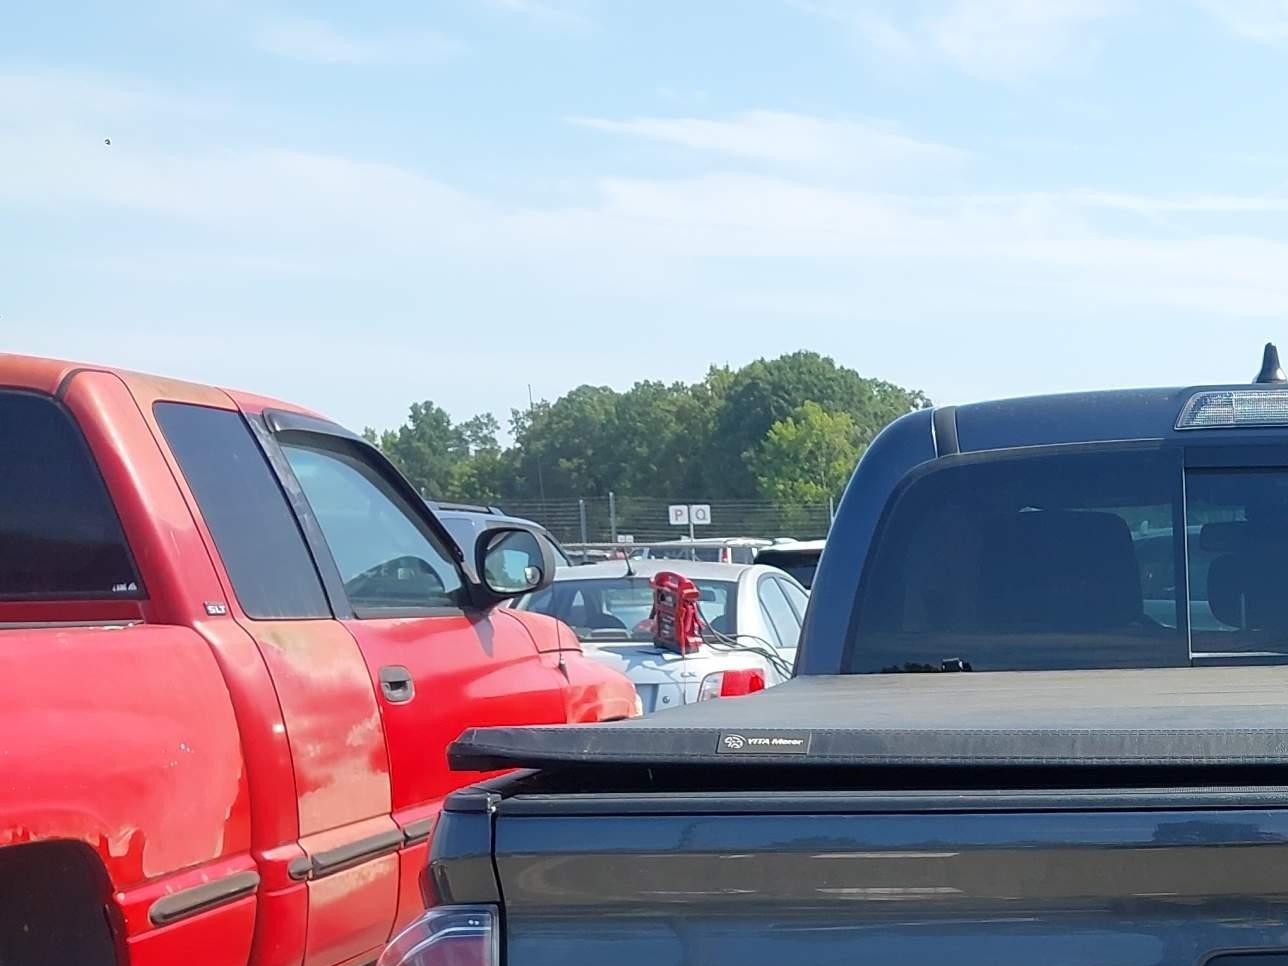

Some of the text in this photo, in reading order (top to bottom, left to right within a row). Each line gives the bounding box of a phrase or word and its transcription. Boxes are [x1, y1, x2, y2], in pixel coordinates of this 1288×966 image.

[674, 508, 683, 521] P
[695, 508, 707, 521] Q
[207, 605, 226, 614] SLT
